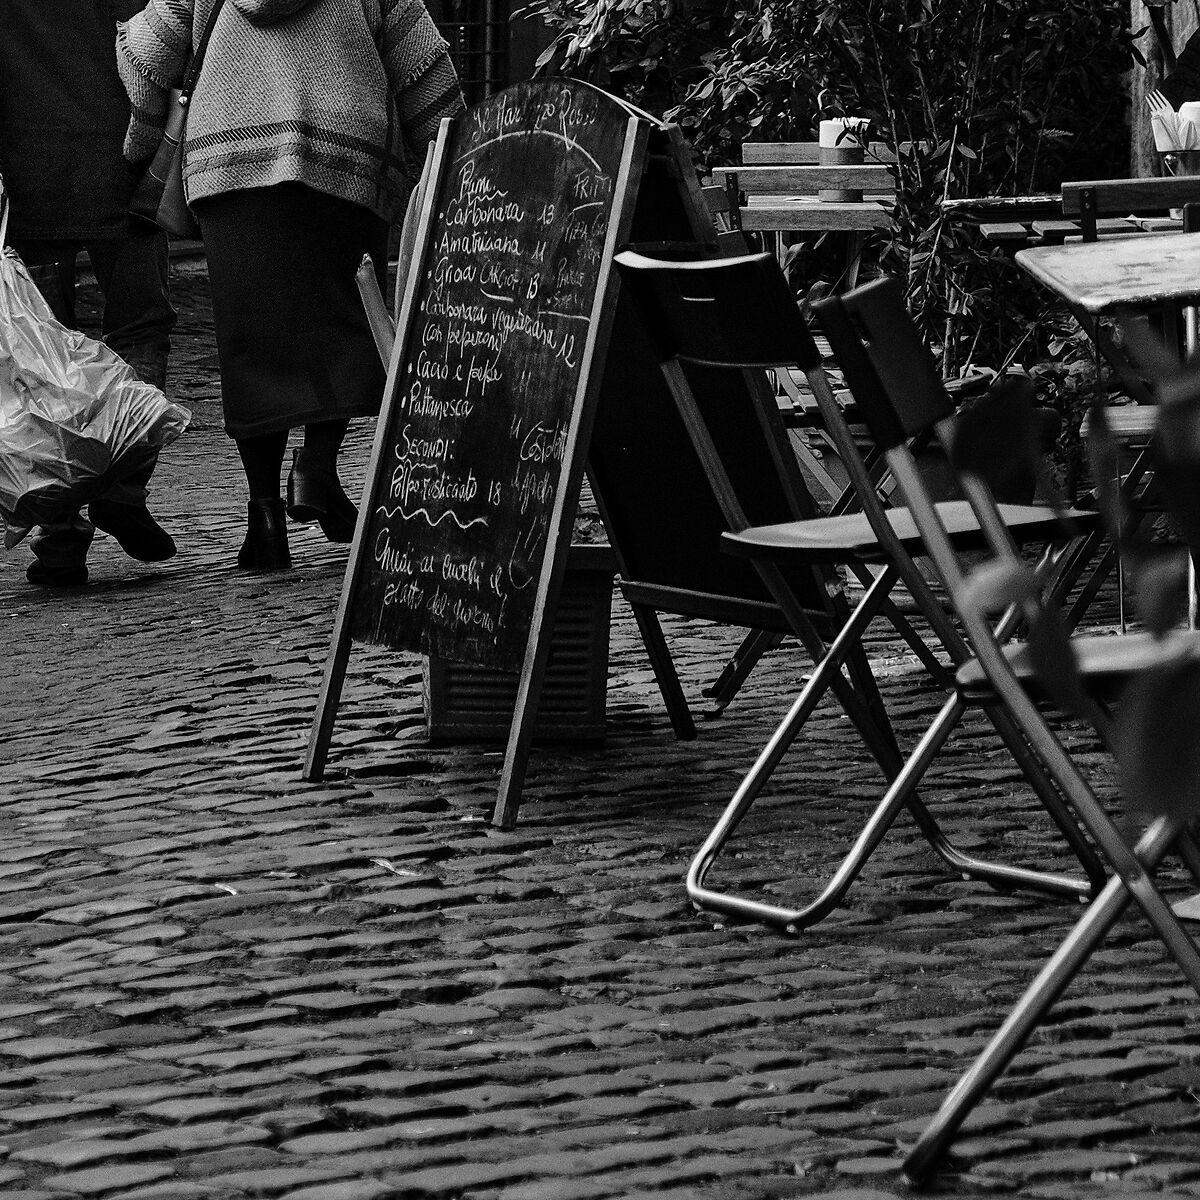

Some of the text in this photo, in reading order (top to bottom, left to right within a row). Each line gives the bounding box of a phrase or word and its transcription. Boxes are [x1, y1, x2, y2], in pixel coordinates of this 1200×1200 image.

[447, 199, 555, 227] Carbonara 13
[439, 230, 524, 256] Amatriciana
[425, 290, 488, 325] Carbonara
[556, 333, 576, 368] 12
[416, 350, 449, 380] Cacio
[453, 363, 464, 382] e
[465, 355, 503, 397] pepe
[390, 464, 420, 506] Polpo
[488, 480, 502, 506] 18
